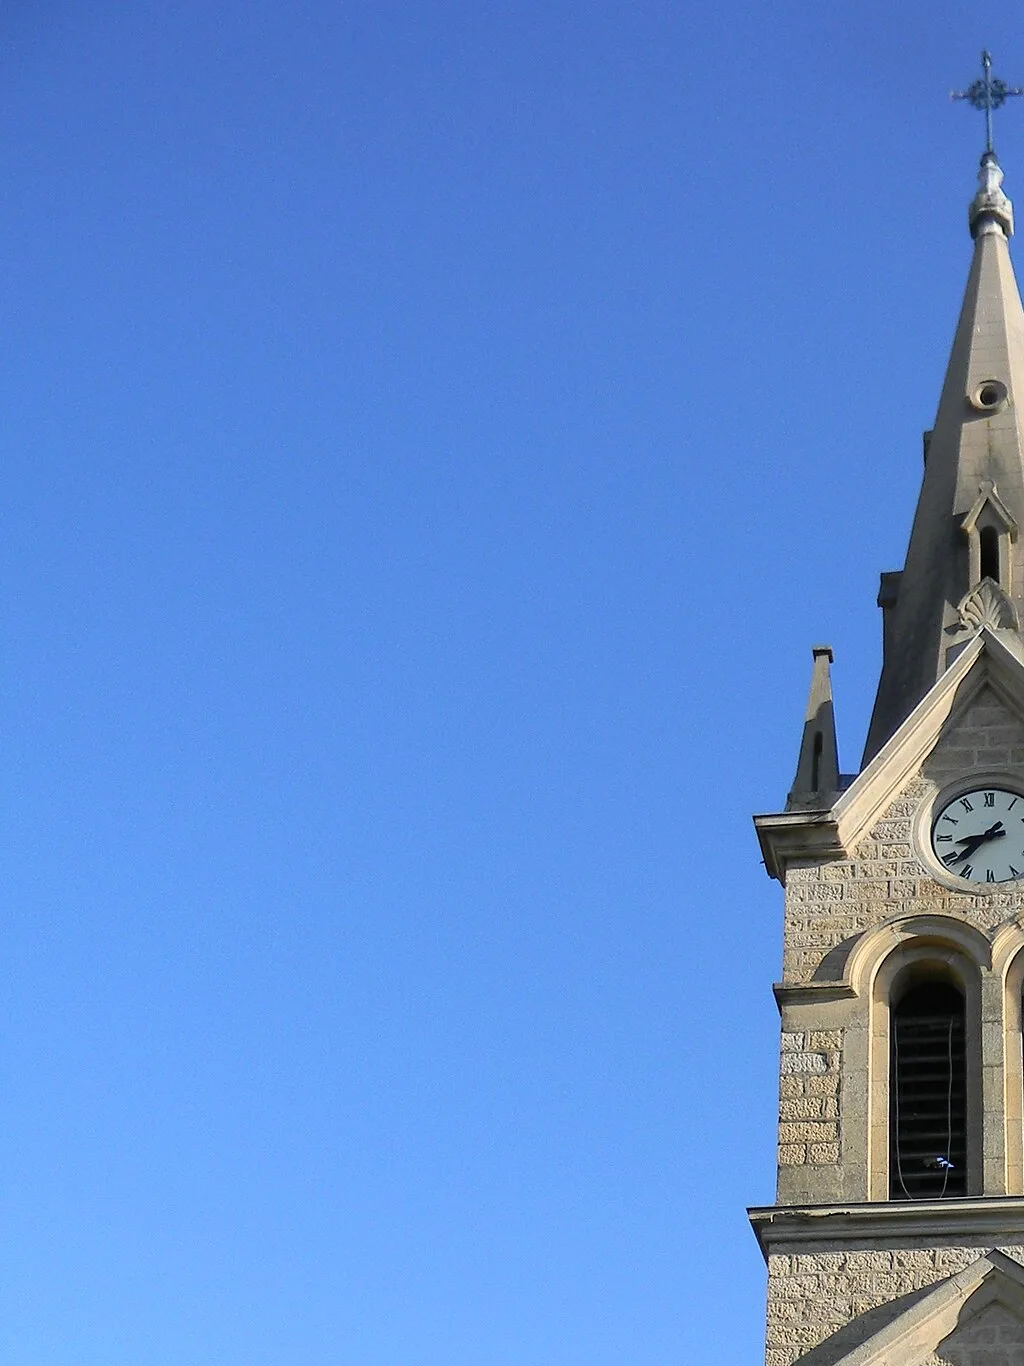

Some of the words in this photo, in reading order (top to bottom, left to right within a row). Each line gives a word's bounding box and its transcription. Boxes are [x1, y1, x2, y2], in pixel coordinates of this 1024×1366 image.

[960, 798, 974, 813] XI
[984, 793, 995, 807] XII
[1007, 798, 1018, 811] I
[942, 814, 959, 825] X
[960, 864, 974, 880] VII
[986, 869, 995, 883] VI
[1009, 864, 1020, 876] V
